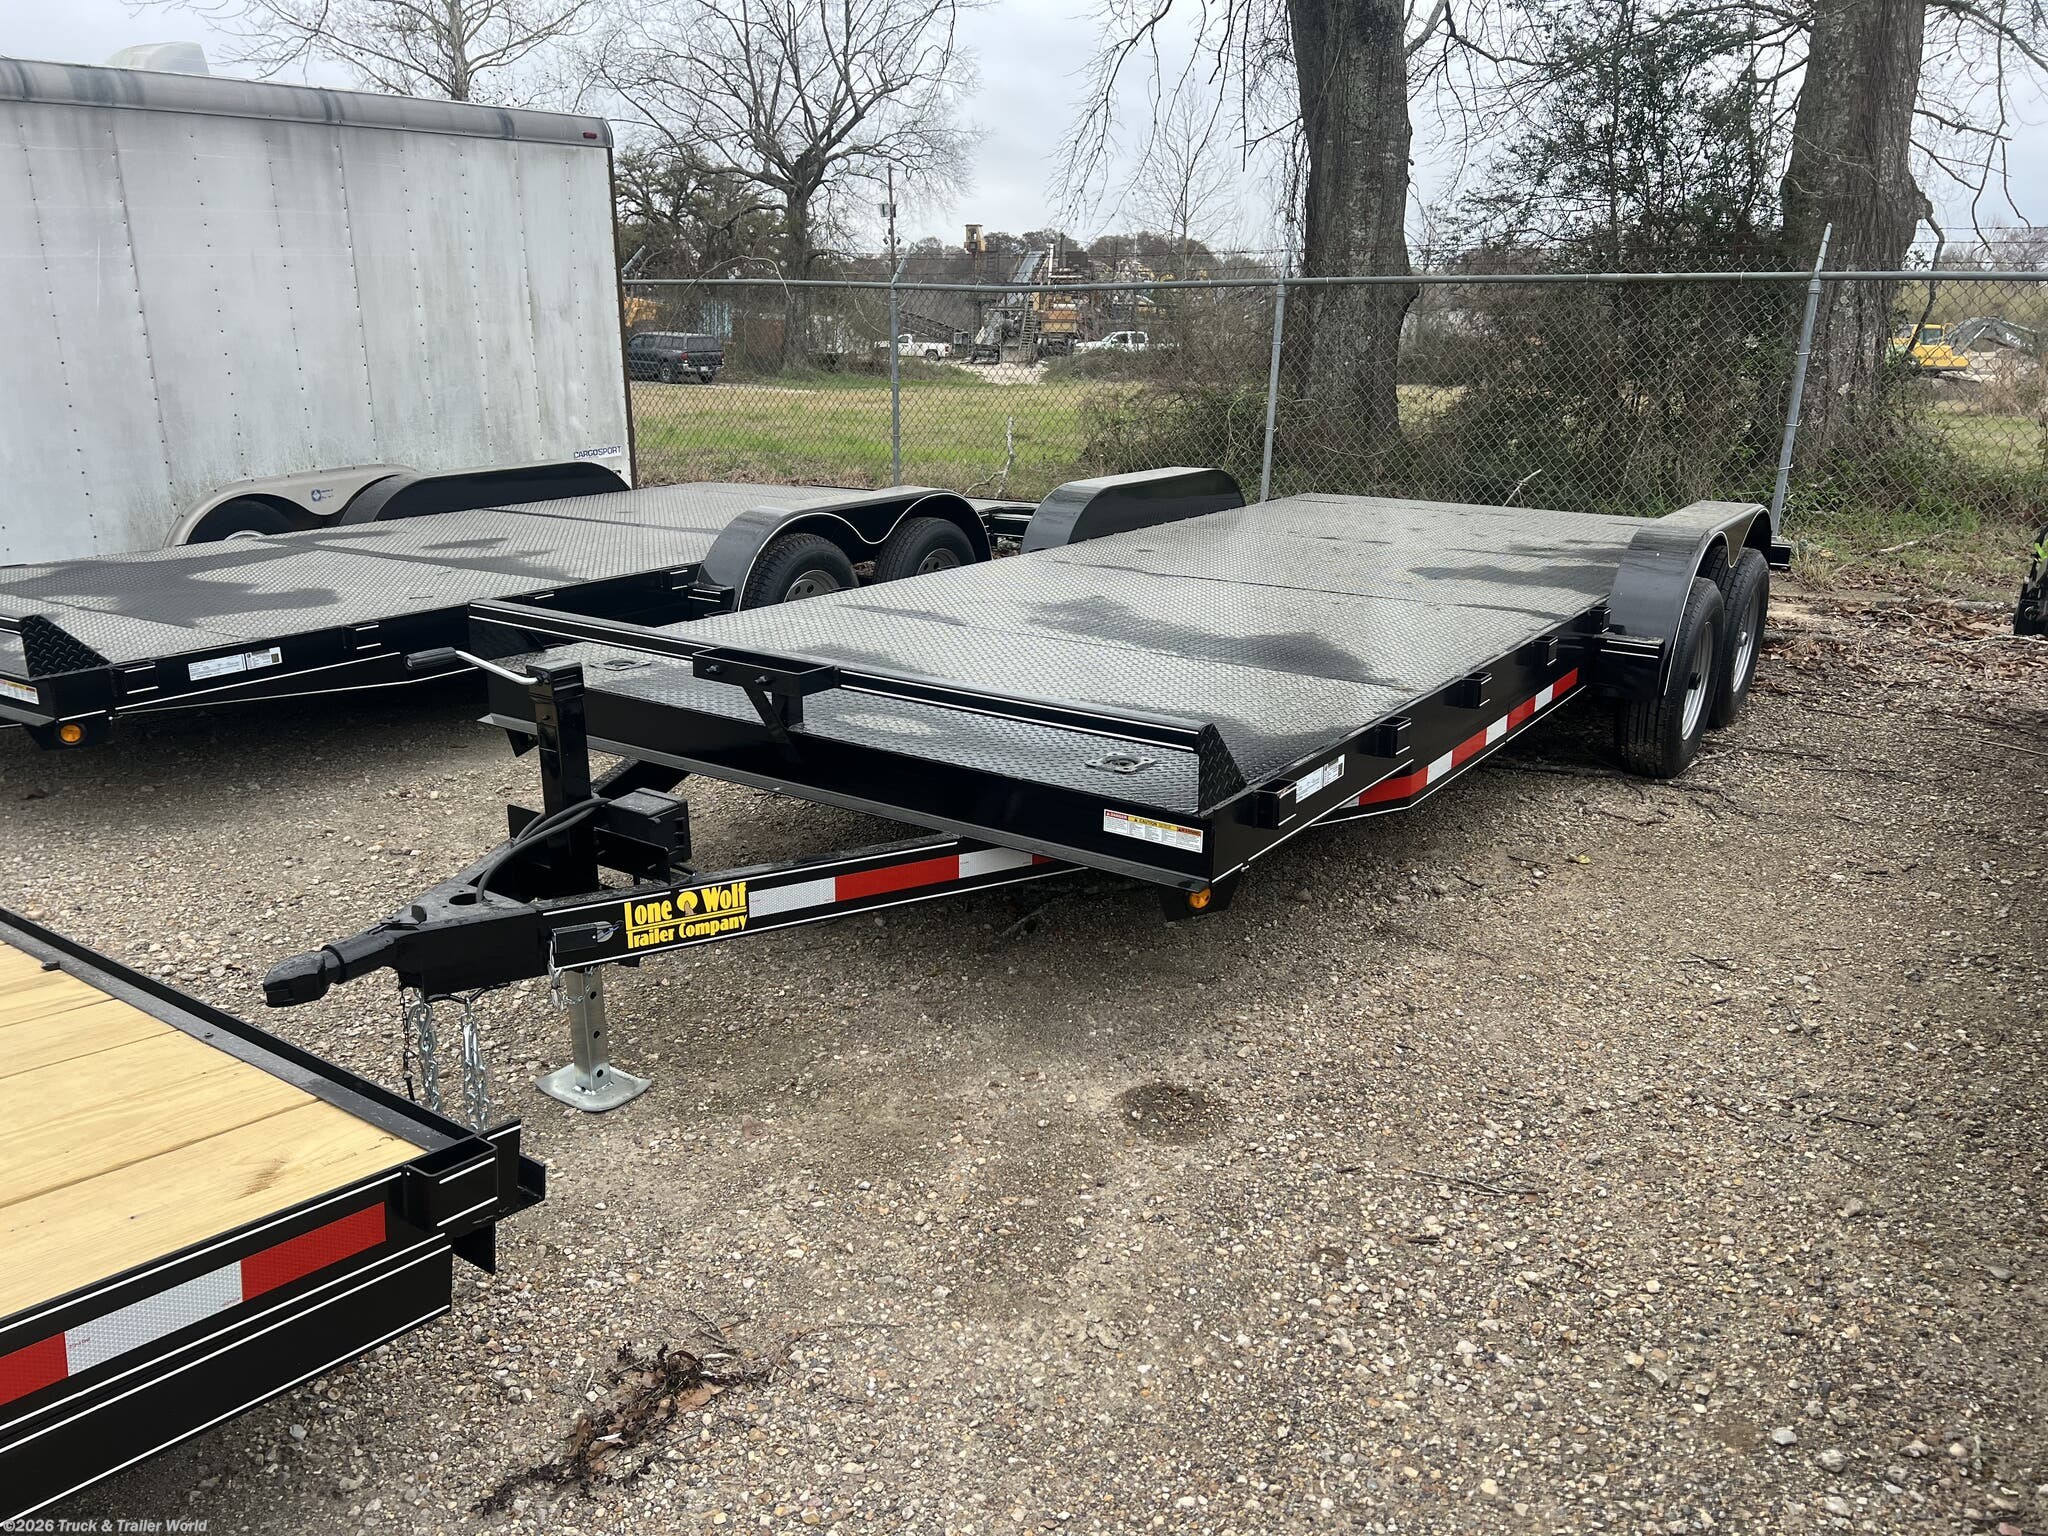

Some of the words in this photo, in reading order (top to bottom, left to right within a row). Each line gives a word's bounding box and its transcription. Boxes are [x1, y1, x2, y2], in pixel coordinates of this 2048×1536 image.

[624, 900, 672, 929] Lone
[701, 882, 746, 912] Wolf
[626, 928, 675, 949] Trailer
[678, 915, 747, 939] Company
